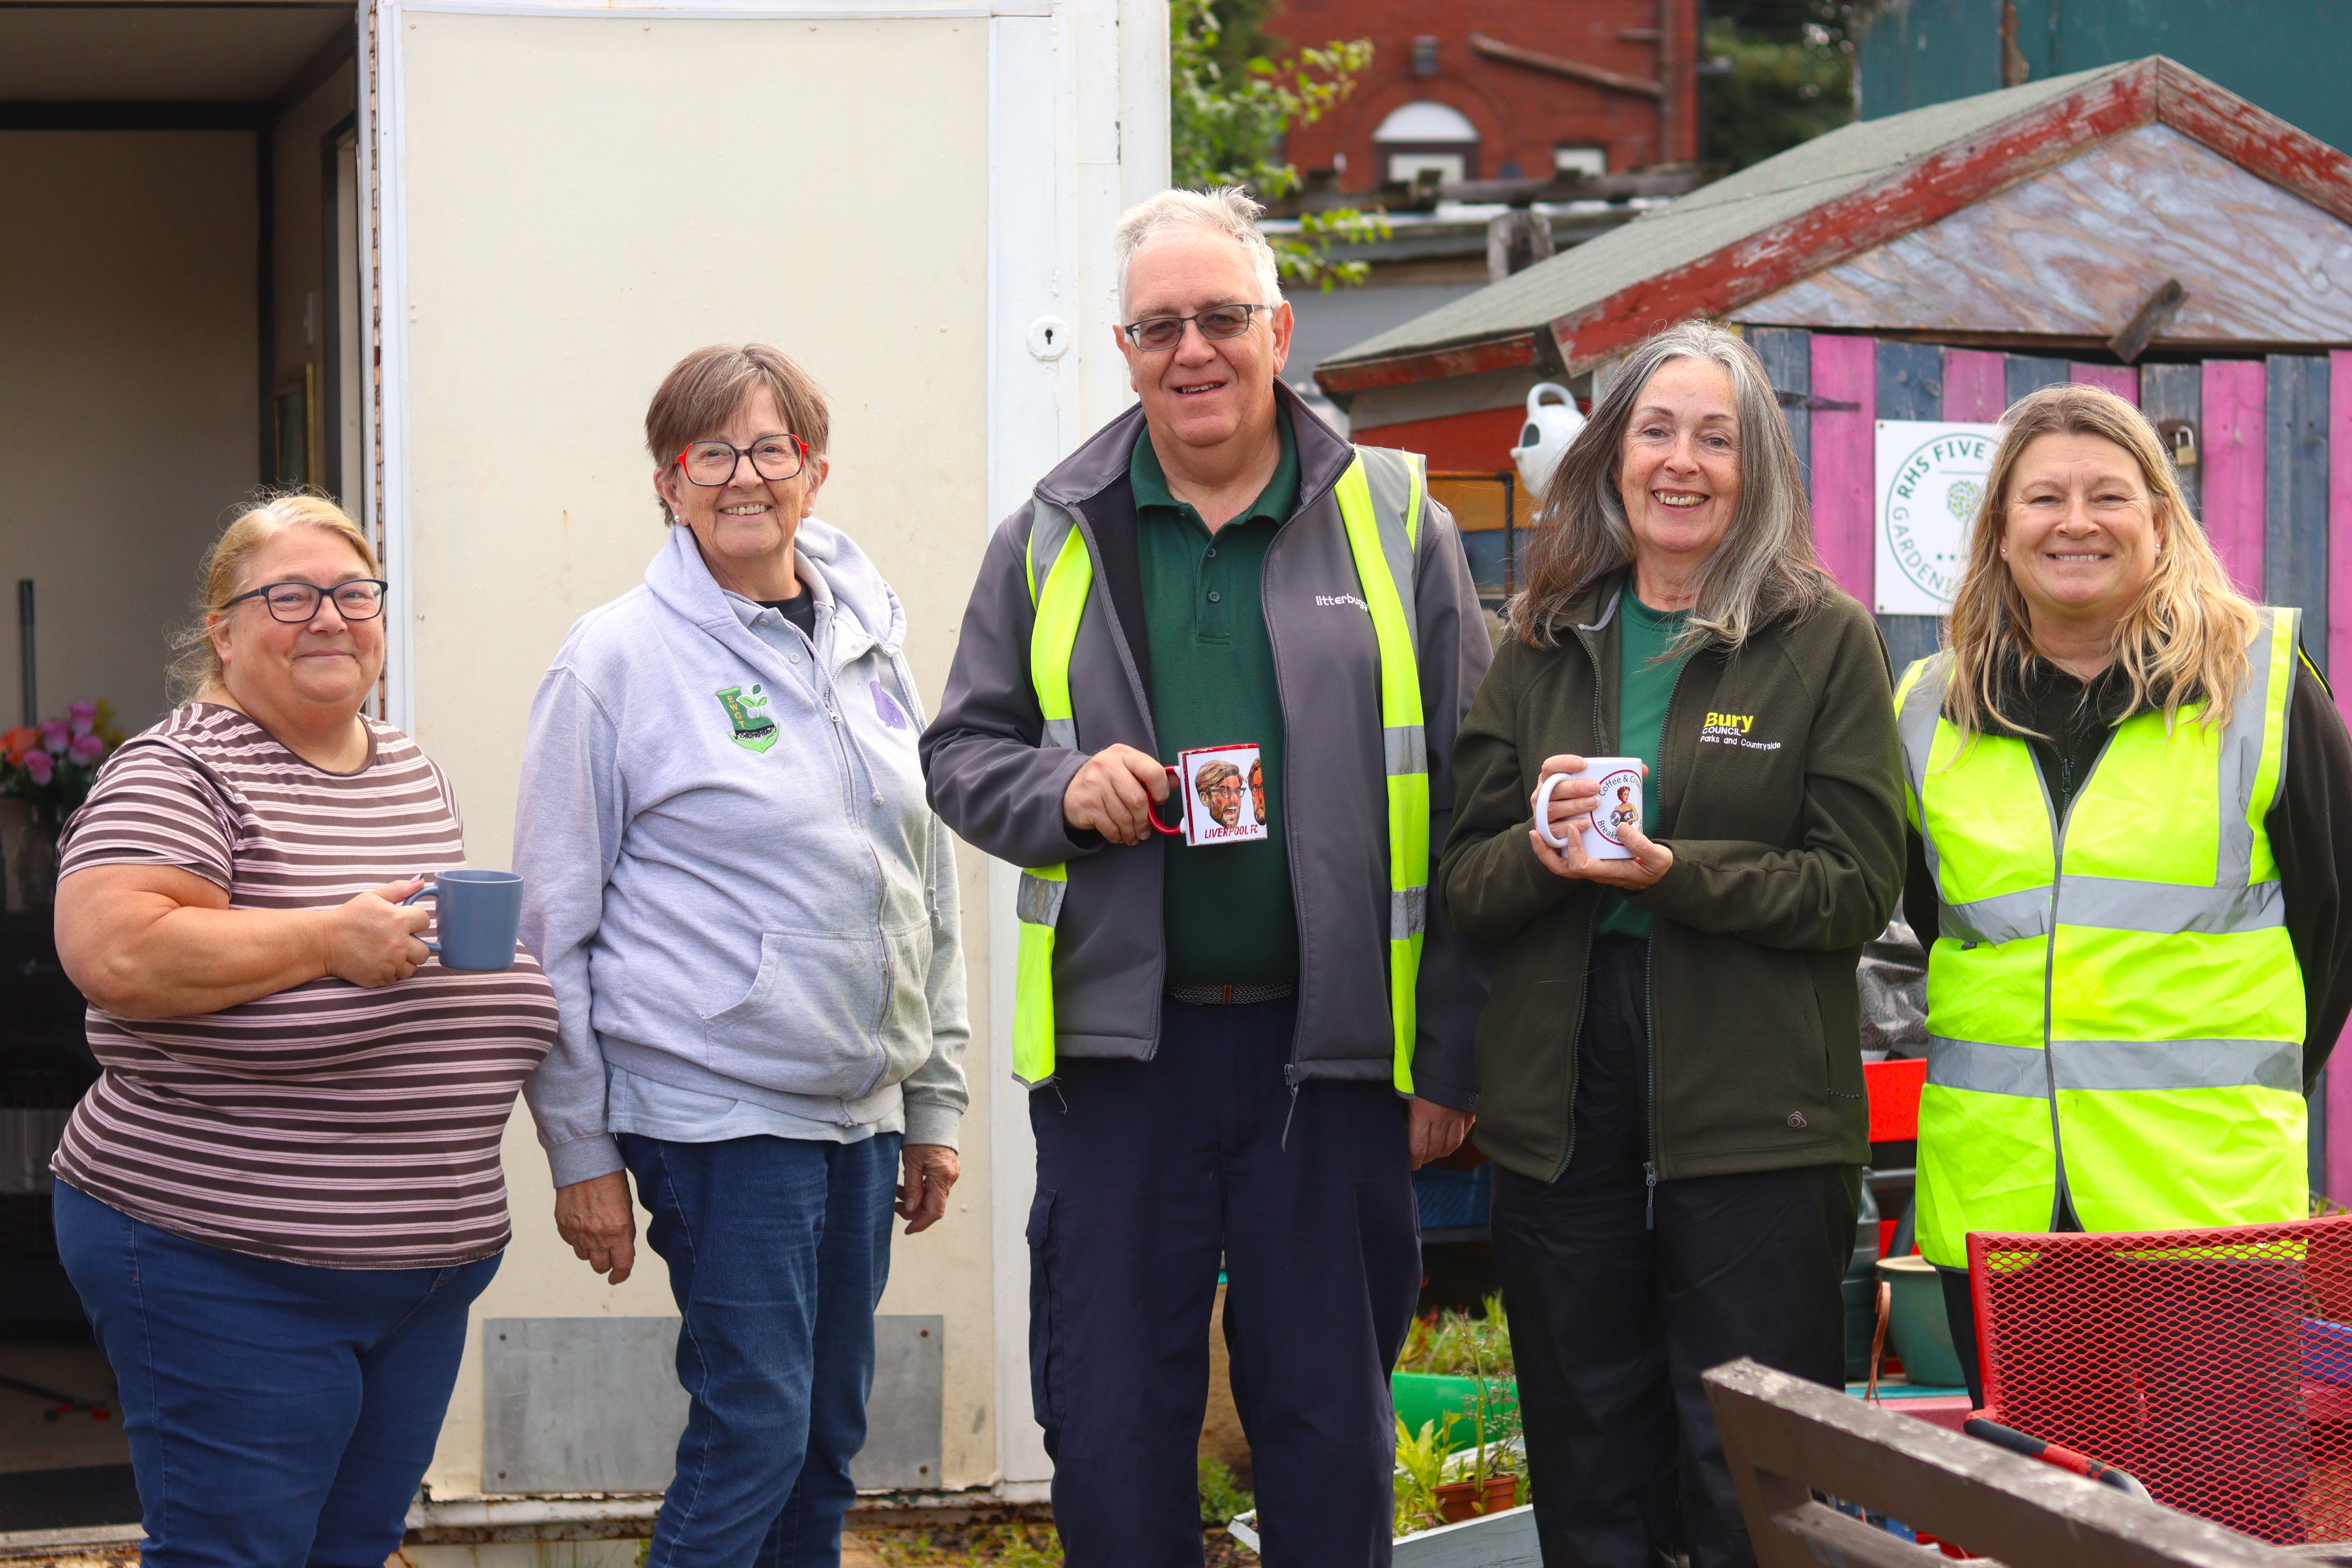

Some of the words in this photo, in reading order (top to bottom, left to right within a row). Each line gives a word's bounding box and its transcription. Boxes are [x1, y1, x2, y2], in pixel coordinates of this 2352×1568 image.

[1897, 456, 1930, 499] RHS
[1933, 440, 1985, 462] FIVE
[1893, 507, 1953, 594] GARDENI
[1316, 593, 1370, 612] litterbugg
[726, 695, 745, 728] EWGT
[1702, 726, 1742, 736] COUNCIL
[1704, 712, 1754, 733] Bury
[1724, 737, 1737, 745] and
[1741, 739, 1781, 751] Countryside
[1599, 777, 1621, 796] Coffee
[1630, 775, 1642, 794] Cream
[1204, 826, 1249, 839] LIVERPOOL
[1250, 824, 1258, 834] FC
